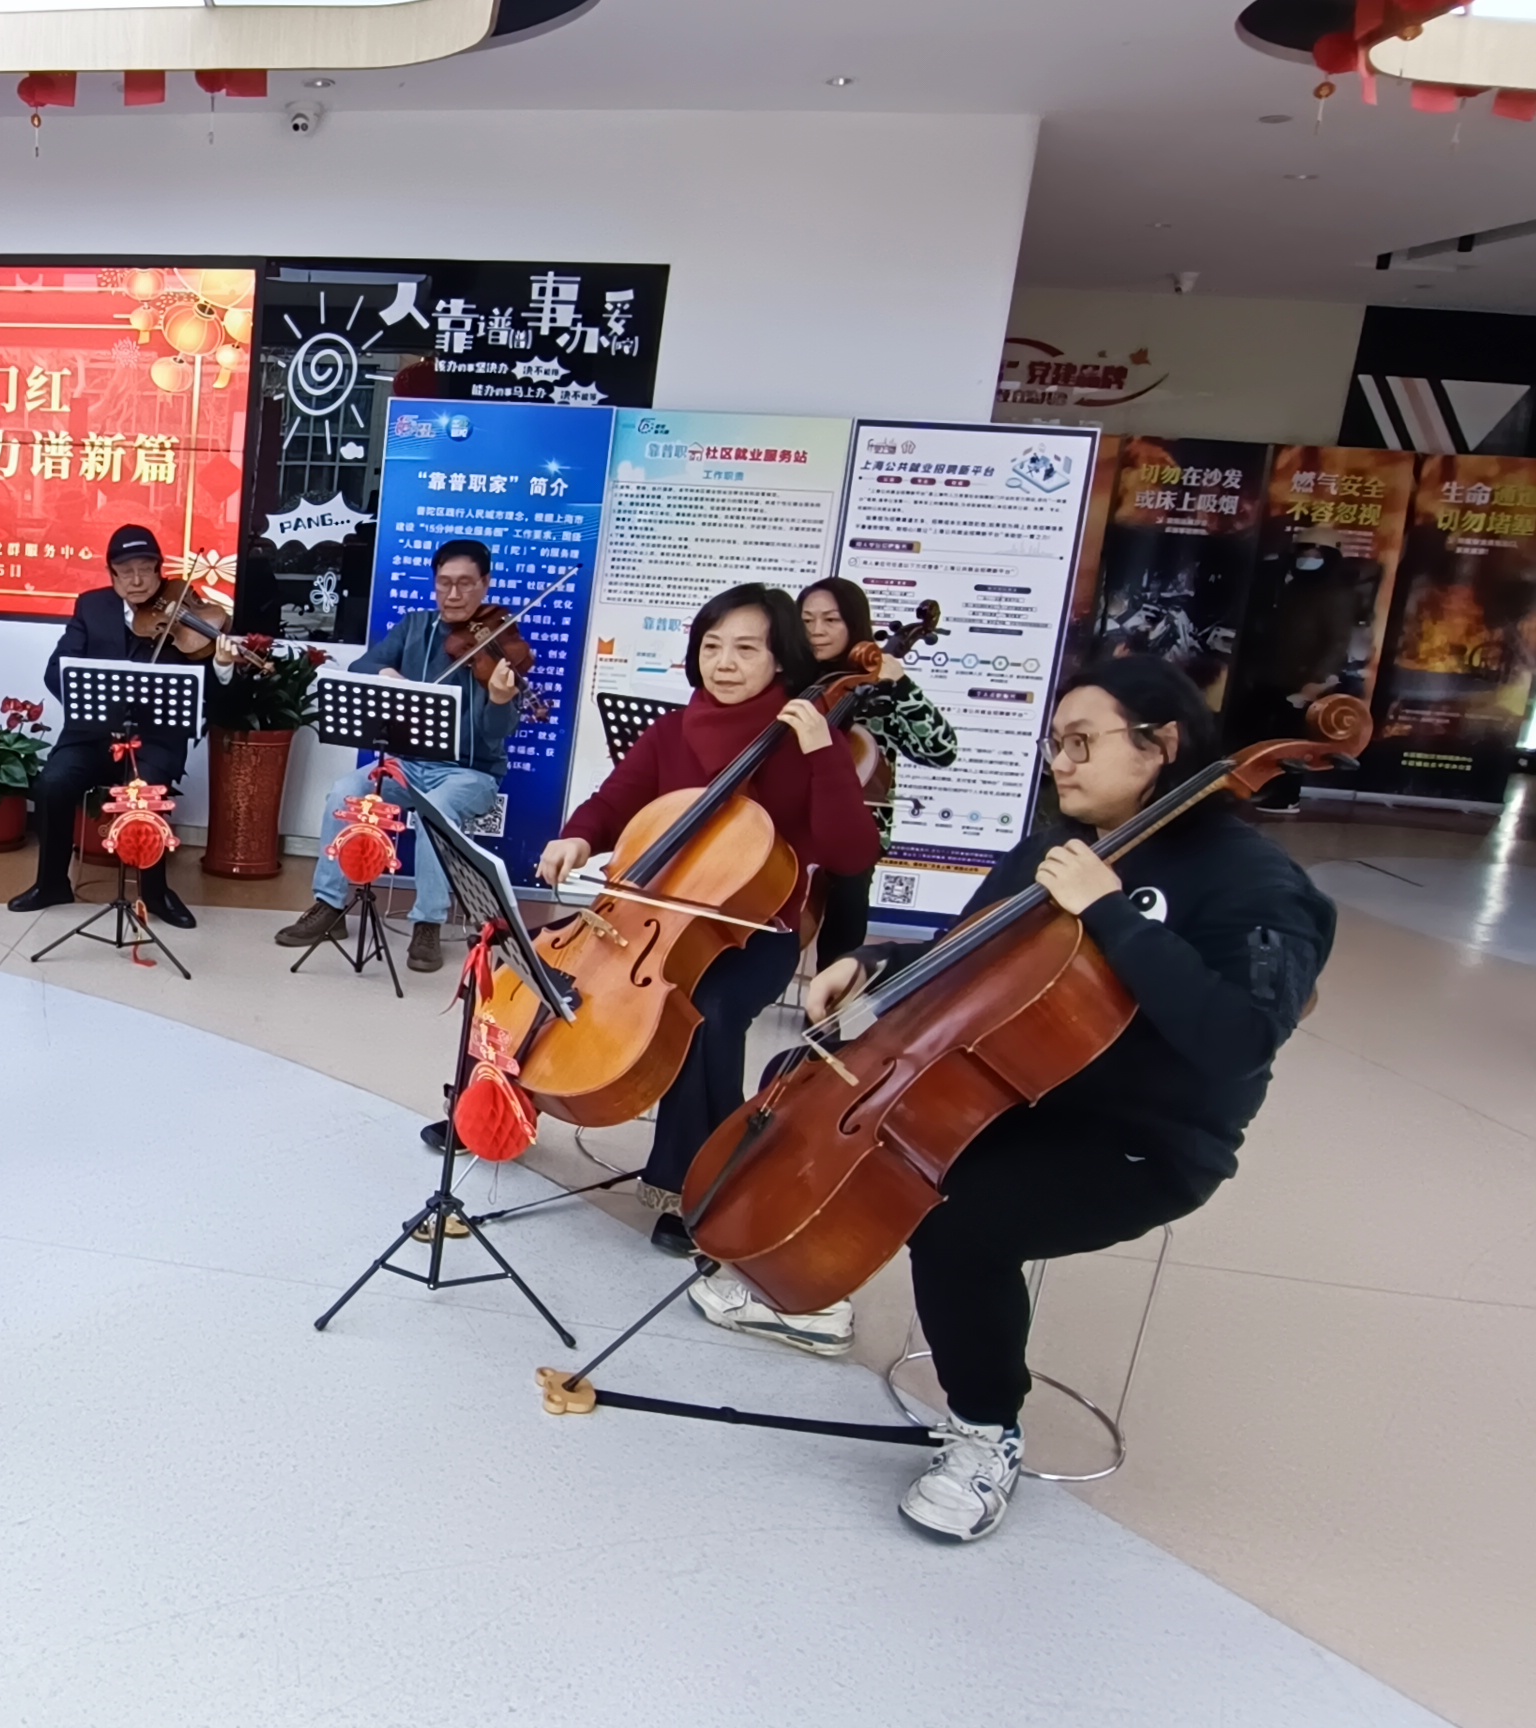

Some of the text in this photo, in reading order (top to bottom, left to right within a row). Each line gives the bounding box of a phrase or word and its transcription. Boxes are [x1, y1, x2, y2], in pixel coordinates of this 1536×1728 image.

[529, 476, 568, 497] 简介
[1139, 463, 1243, 490] 切勿在沙发
[1290, 470, 1386, 499] 燃气安全
[1134, 490, 1240, 515] 或床上吸烟
[1440, 481, 1536, 508] 生命通道
[279, 512, 351, 534] PANG...
[1286, 501, 1383, 526] 不容忽视
[1436, 506, 1536, 536] 切勿堵塞
